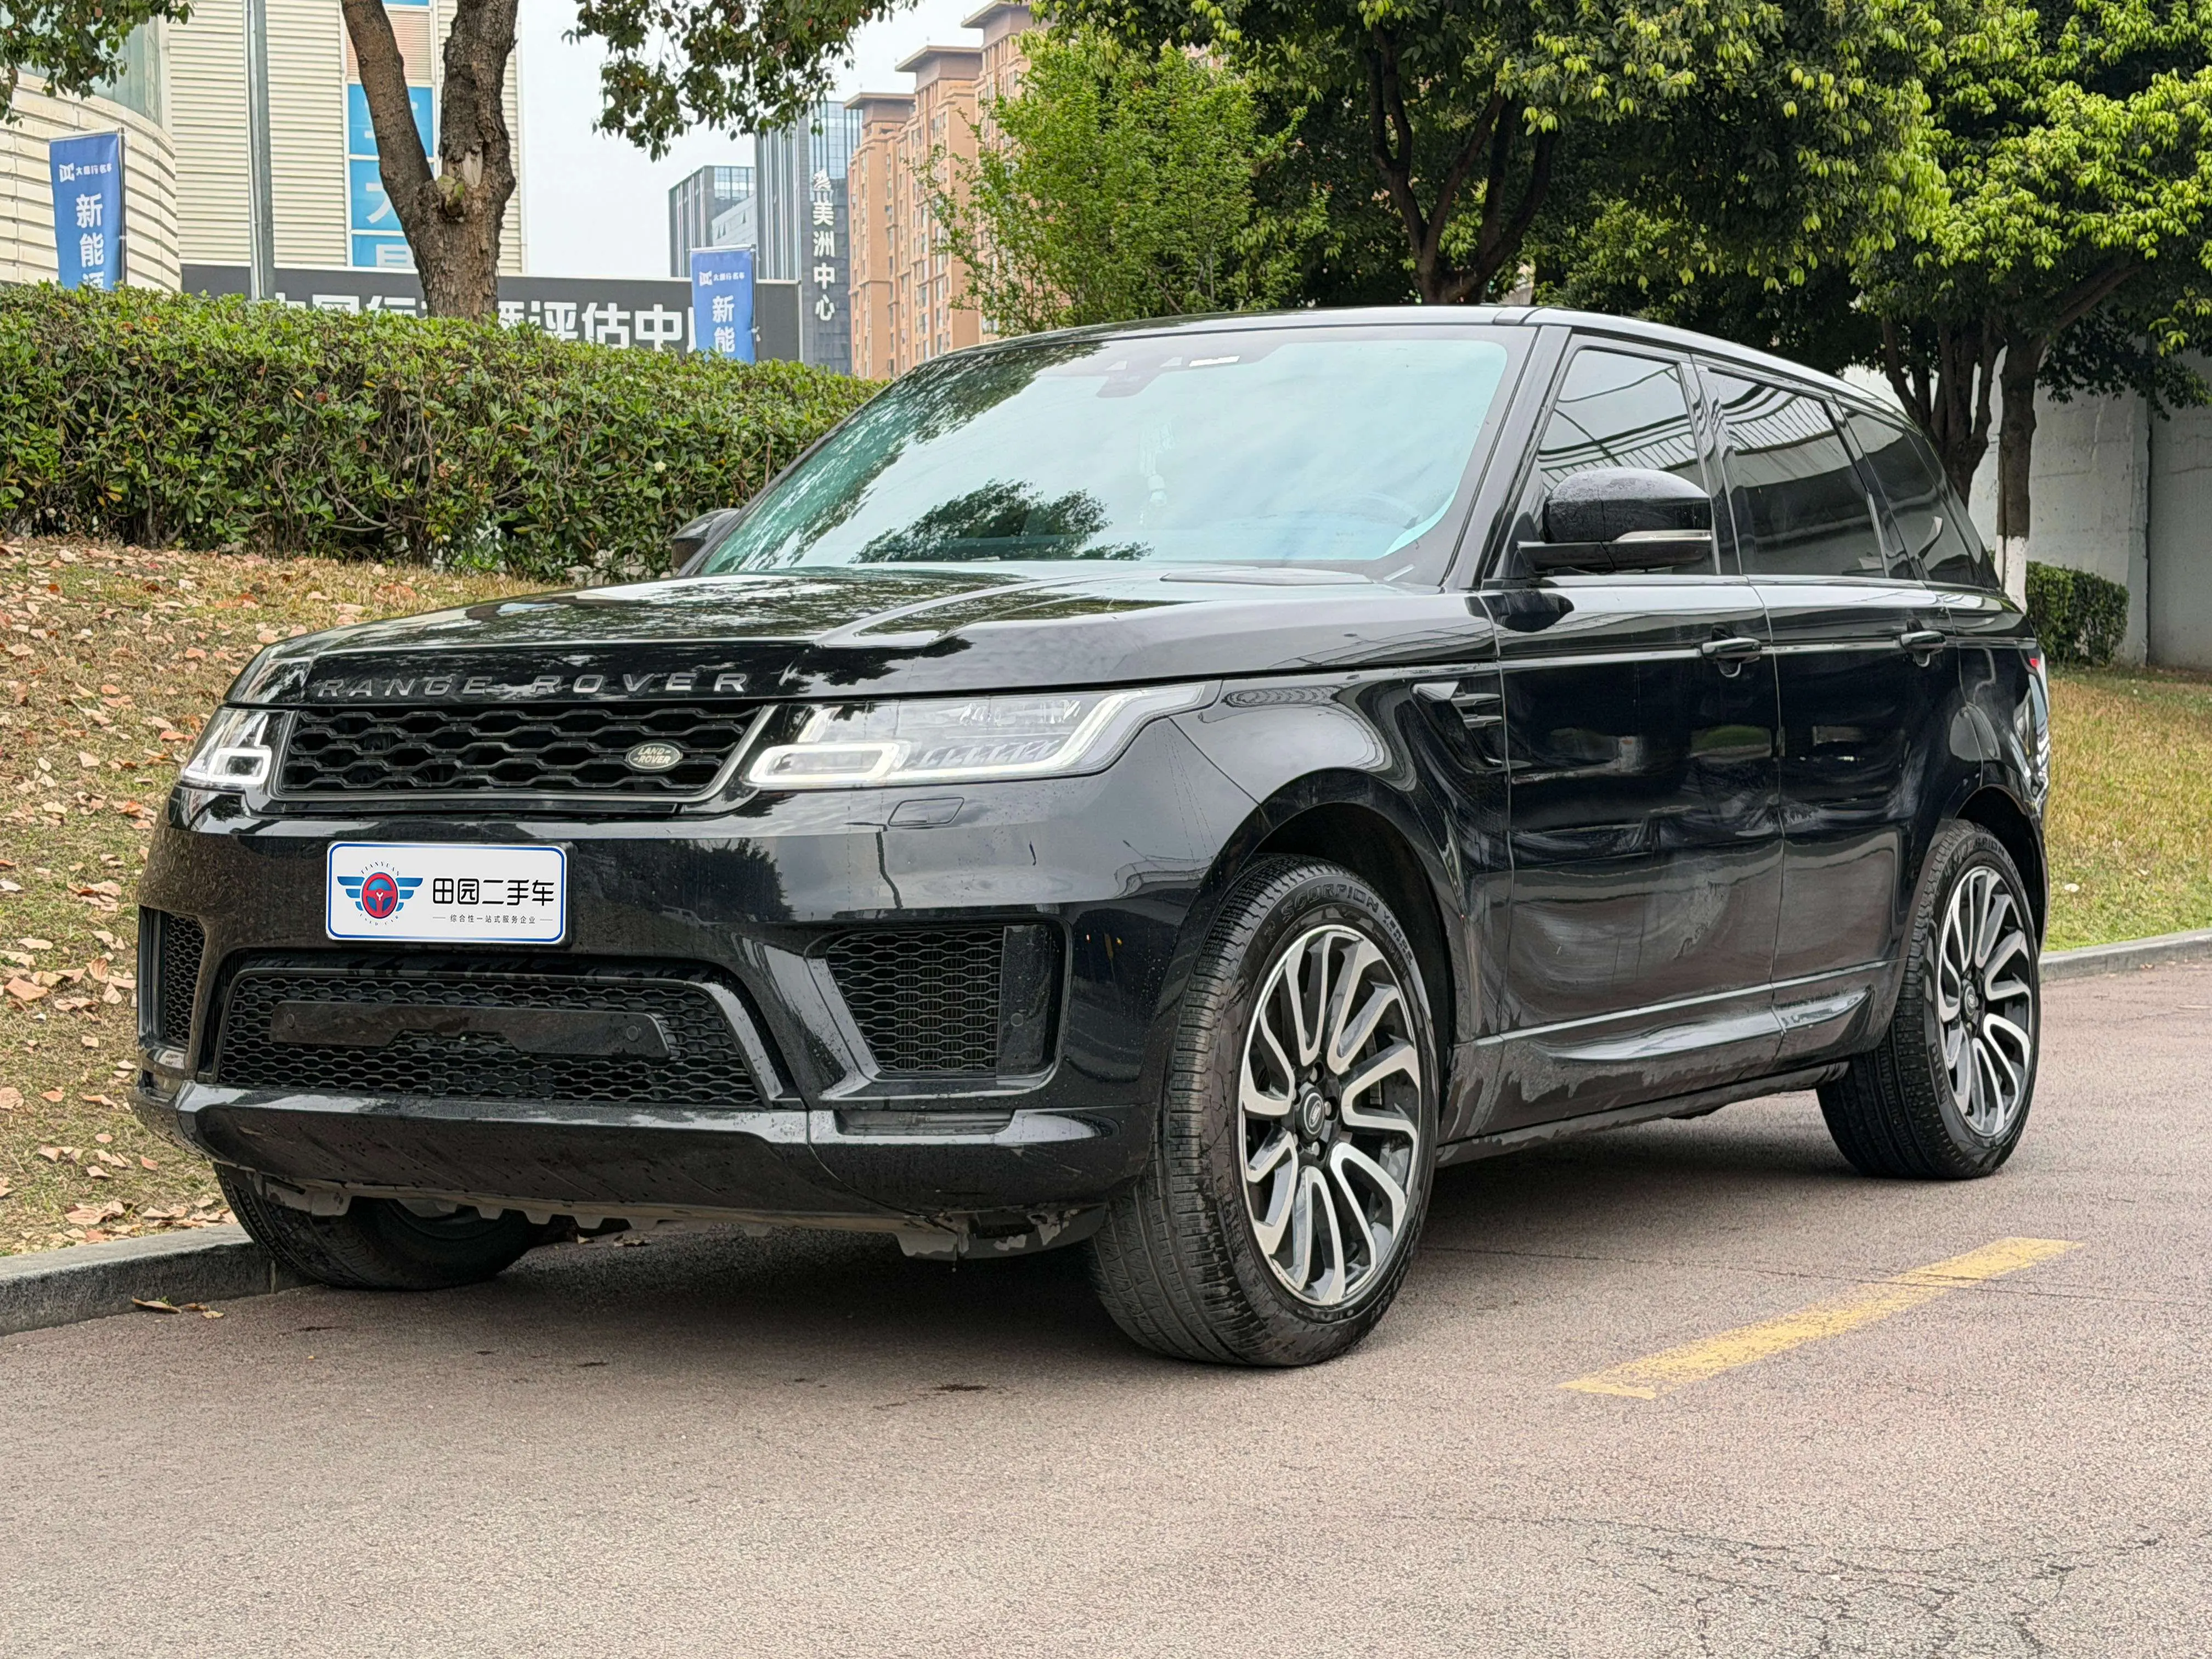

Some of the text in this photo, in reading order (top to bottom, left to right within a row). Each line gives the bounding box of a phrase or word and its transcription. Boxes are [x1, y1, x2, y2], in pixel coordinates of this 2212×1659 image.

[812, 201, 835, 321] 美洲中心
[498, 301, 696, 353] 评估中
[713, 295, 735, 352] 新能
[318, 672, 747, 697] RANGE ROVER
[637, 755, 671, 764] ROVER
[638, 747, 665, 755] LAND
[433, 878, 554, 906] 田园二手车
[1281, 883, 1379, 923] SCORPION
[450, 914, 535, 924] 综合性一站式服务企业
